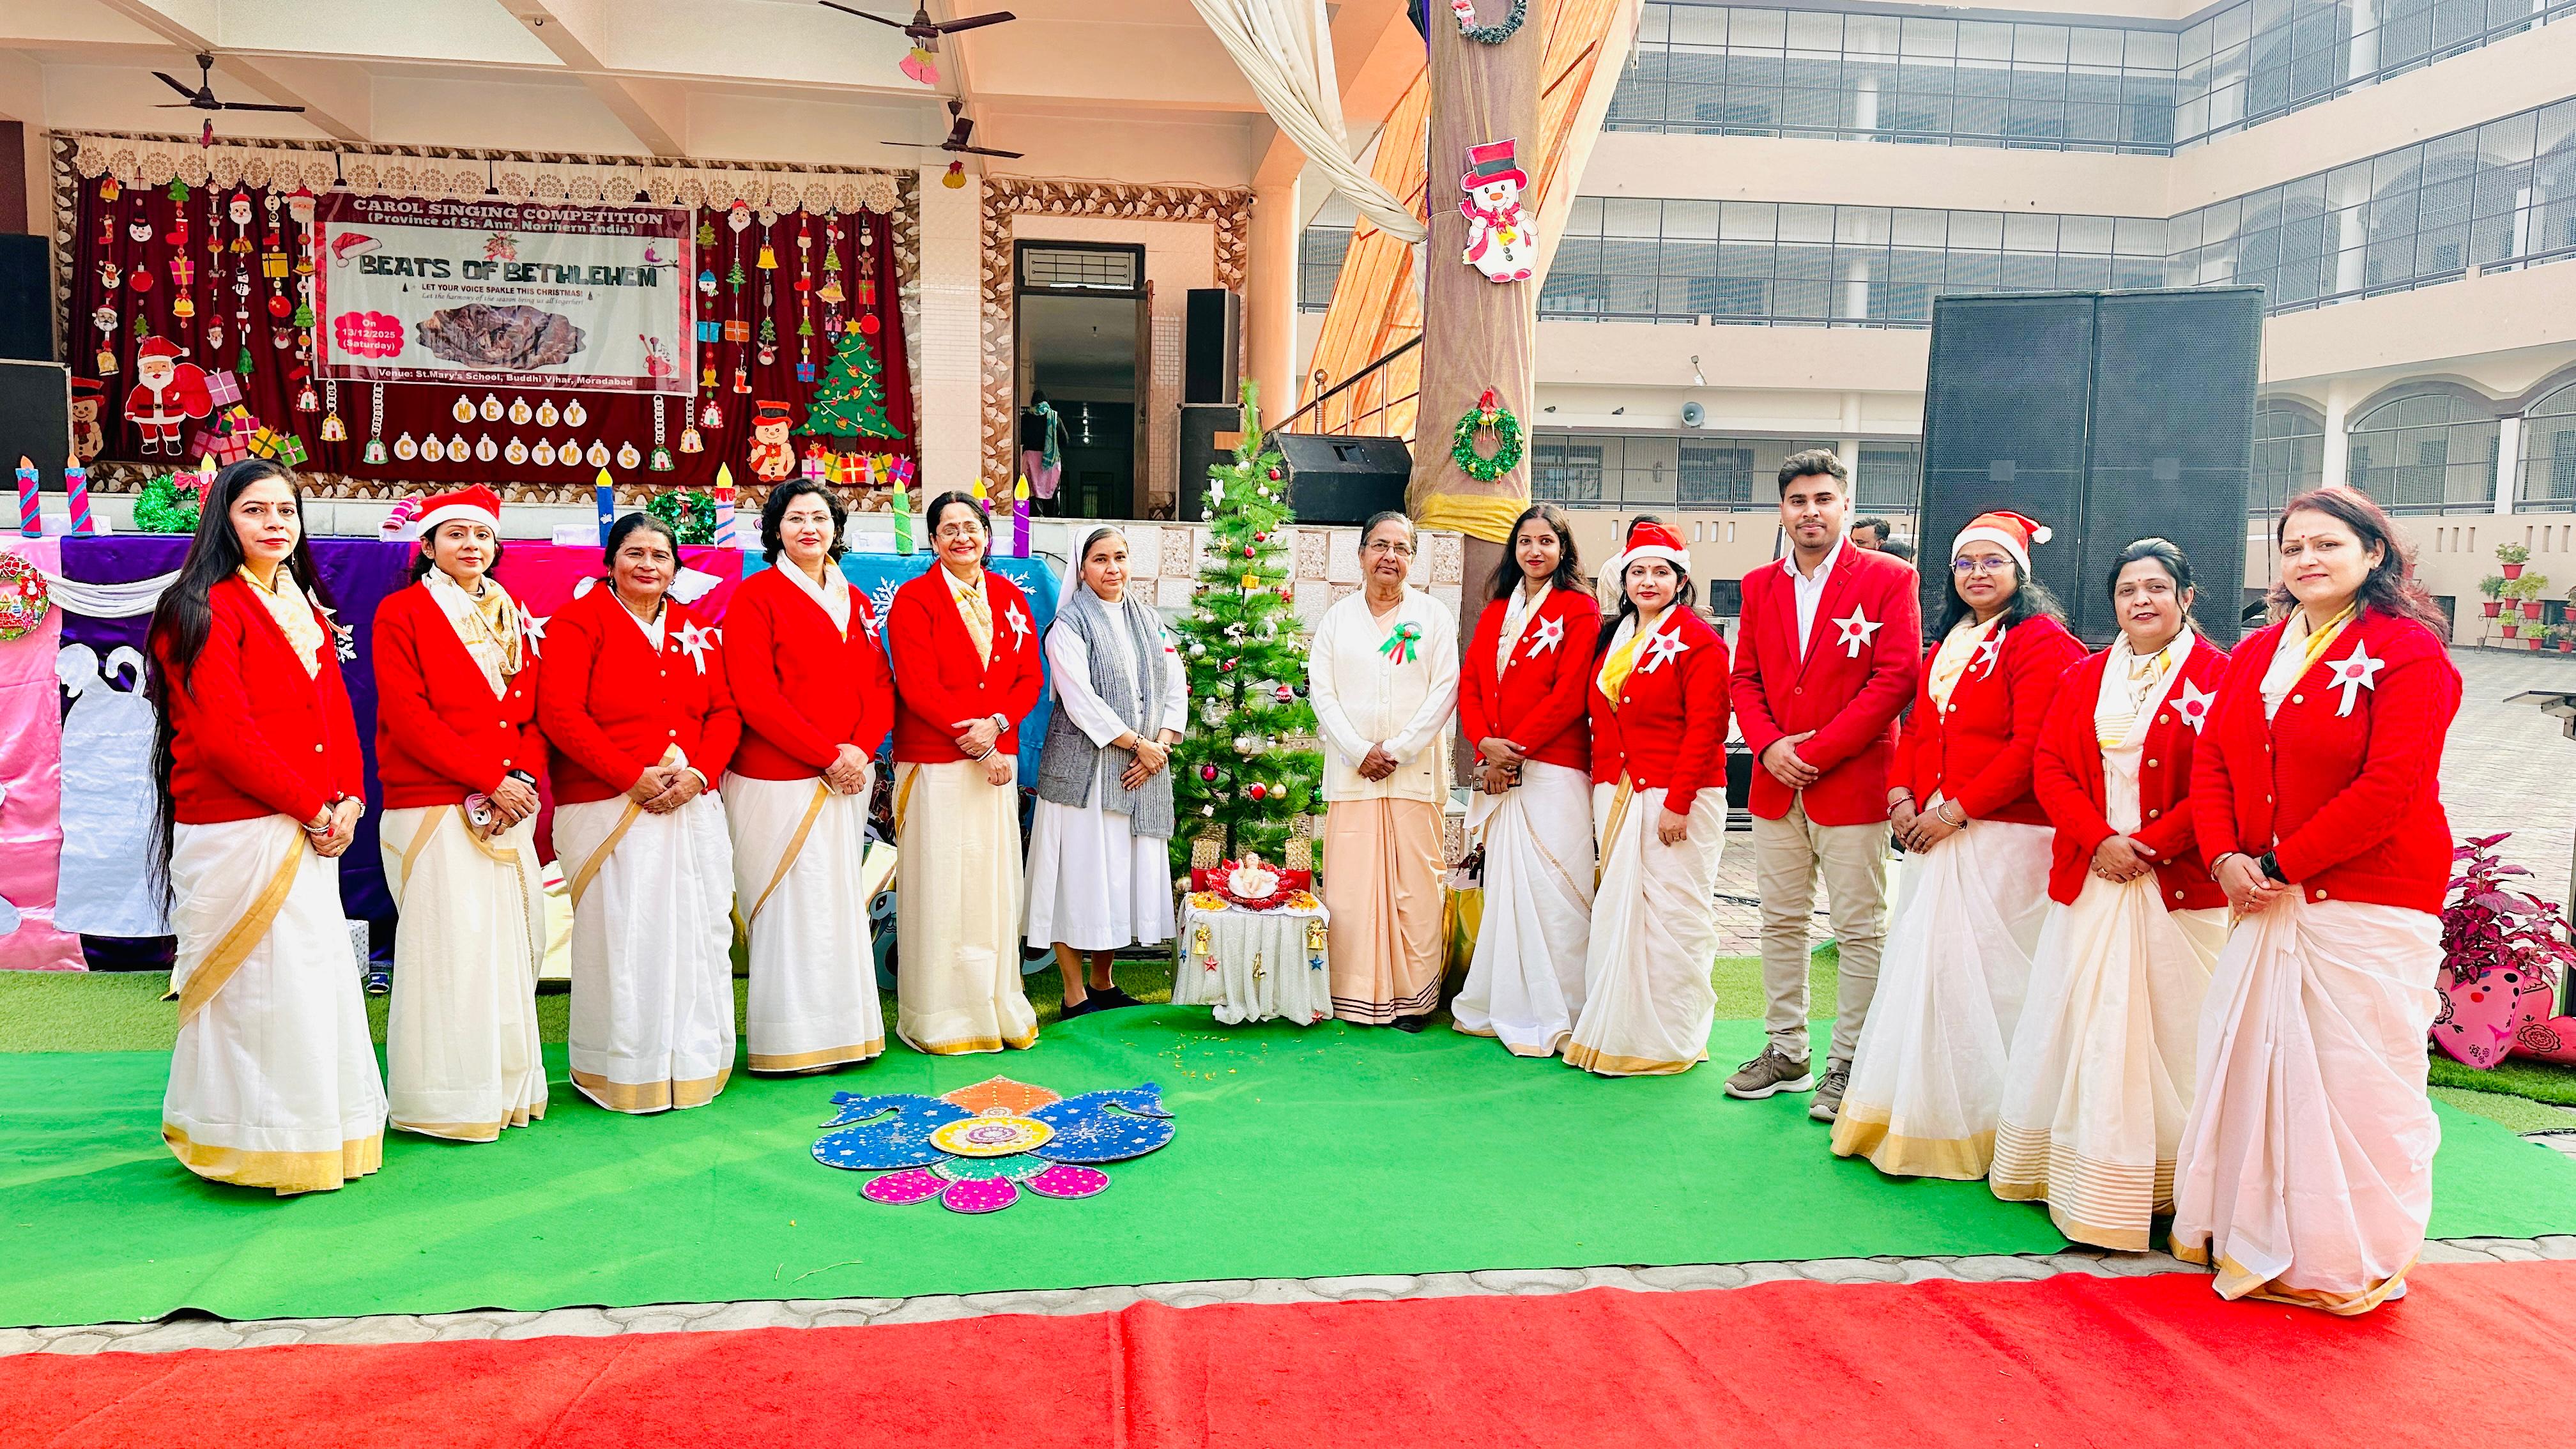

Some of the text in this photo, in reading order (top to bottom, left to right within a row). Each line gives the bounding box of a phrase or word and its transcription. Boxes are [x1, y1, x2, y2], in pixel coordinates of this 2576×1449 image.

[353, 199, 664, 224] CAROL SINGING COMPETITION
[368, 212, 635, 235] (Province of St. Ann, Northern India)
[360, 255, 657, 287] BEATS OF BETHLEHEM
[447, 293, 473, 302] harmony
[475, 294, 483, 302] of
[537, 288, 583, 296] CHRISTMAS!
[362, 319, 376, 327] On
[342, 328, 395, 339] 13/12/2025
[343, 339, 395, 351] (Saturday)
[378, 369, 413, 378] Venue:
[466, 372, 503, 382] School,
[506, 374, 542, 383] Buddhi
[544, 375, 574, 385] Vihar,
[576, 376, 633, 386] Moradabad
[457, 402, 580, 425] MERRY
[399, 440, 636, 467] CHRISTMAS
